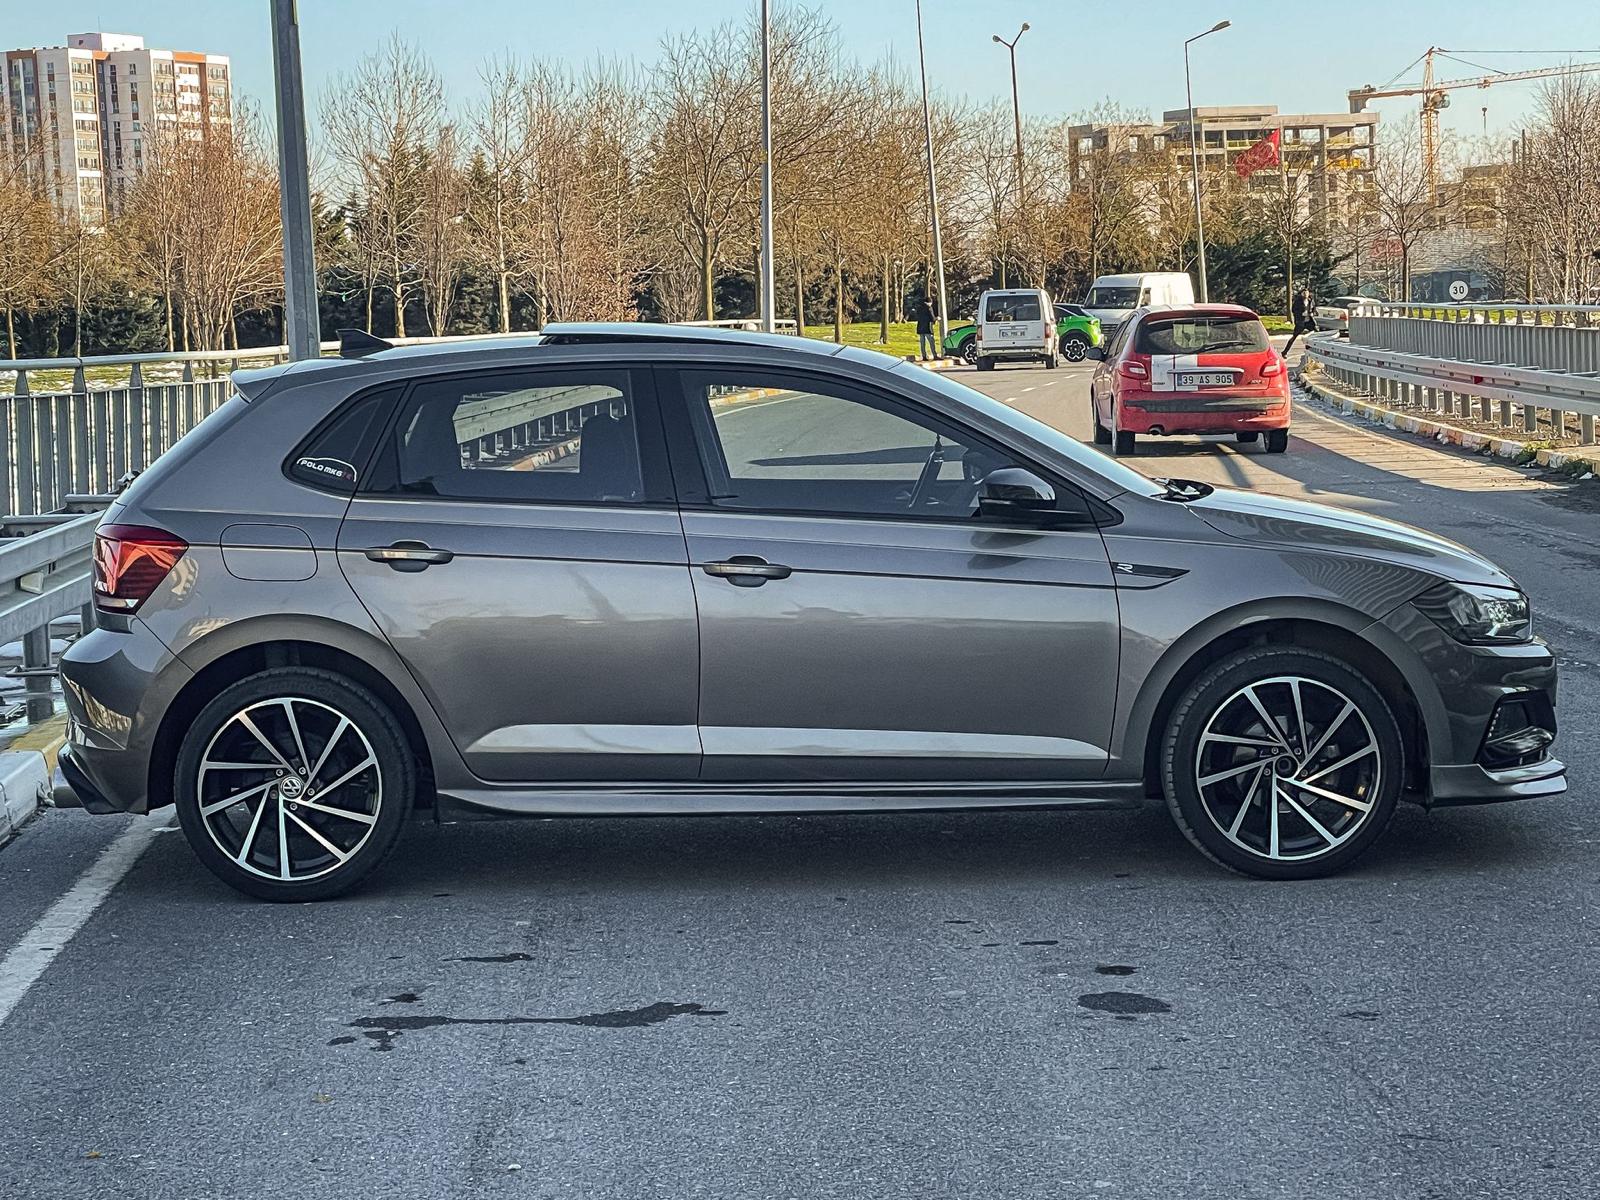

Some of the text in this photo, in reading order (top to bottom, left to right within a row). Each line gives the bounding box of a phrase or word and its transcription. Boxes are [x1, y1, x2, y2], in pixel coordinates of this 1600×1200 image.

[1453, 286, 1464, 294] 30
[1182, 374, 1233, 385] 39 AS 905
[300, 459, 325, 471] POLO
[1116, 563, 1133, 573] R
